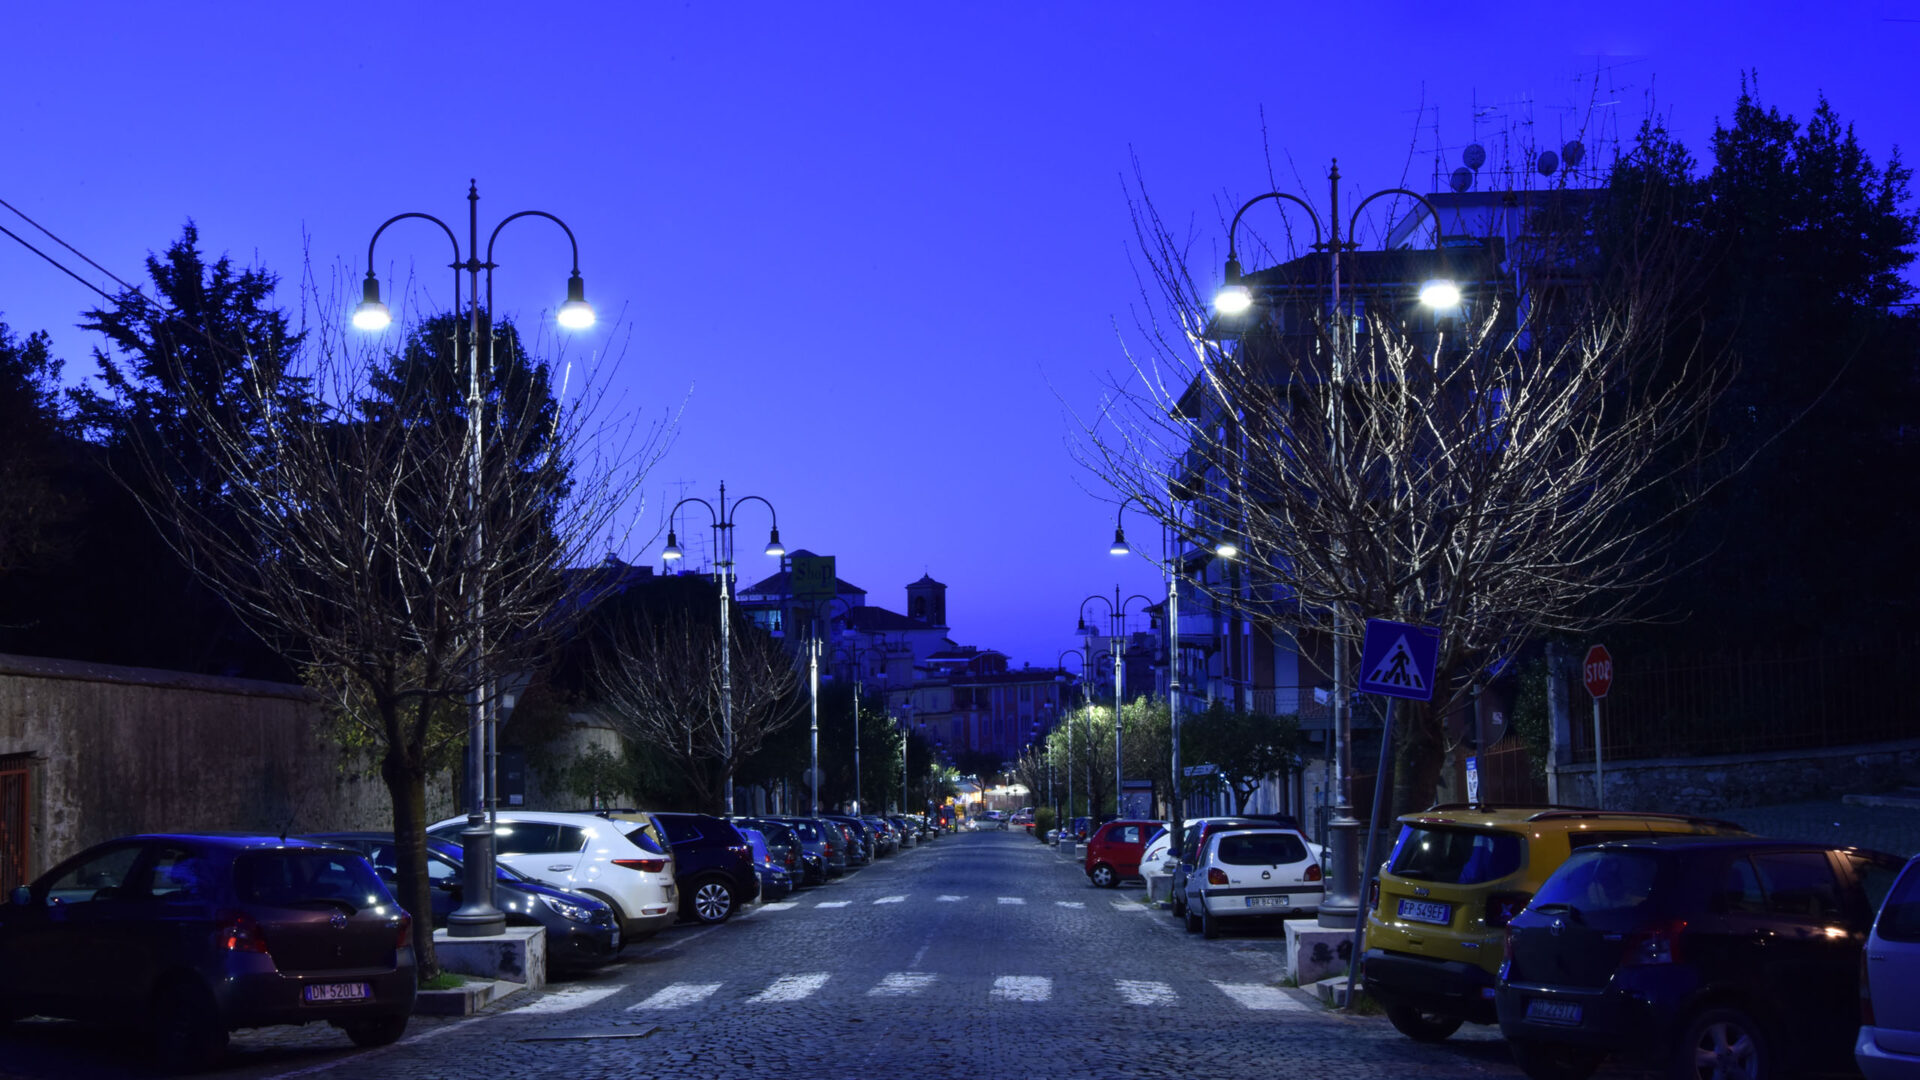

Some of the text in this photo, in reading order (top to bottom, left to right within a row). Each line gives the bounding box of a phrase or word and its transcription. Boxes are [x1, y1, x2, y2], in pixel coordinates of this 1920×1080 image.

[1587, 660, 1609, 683] STOP
[312, 983, 363, 998] DN 520LX
